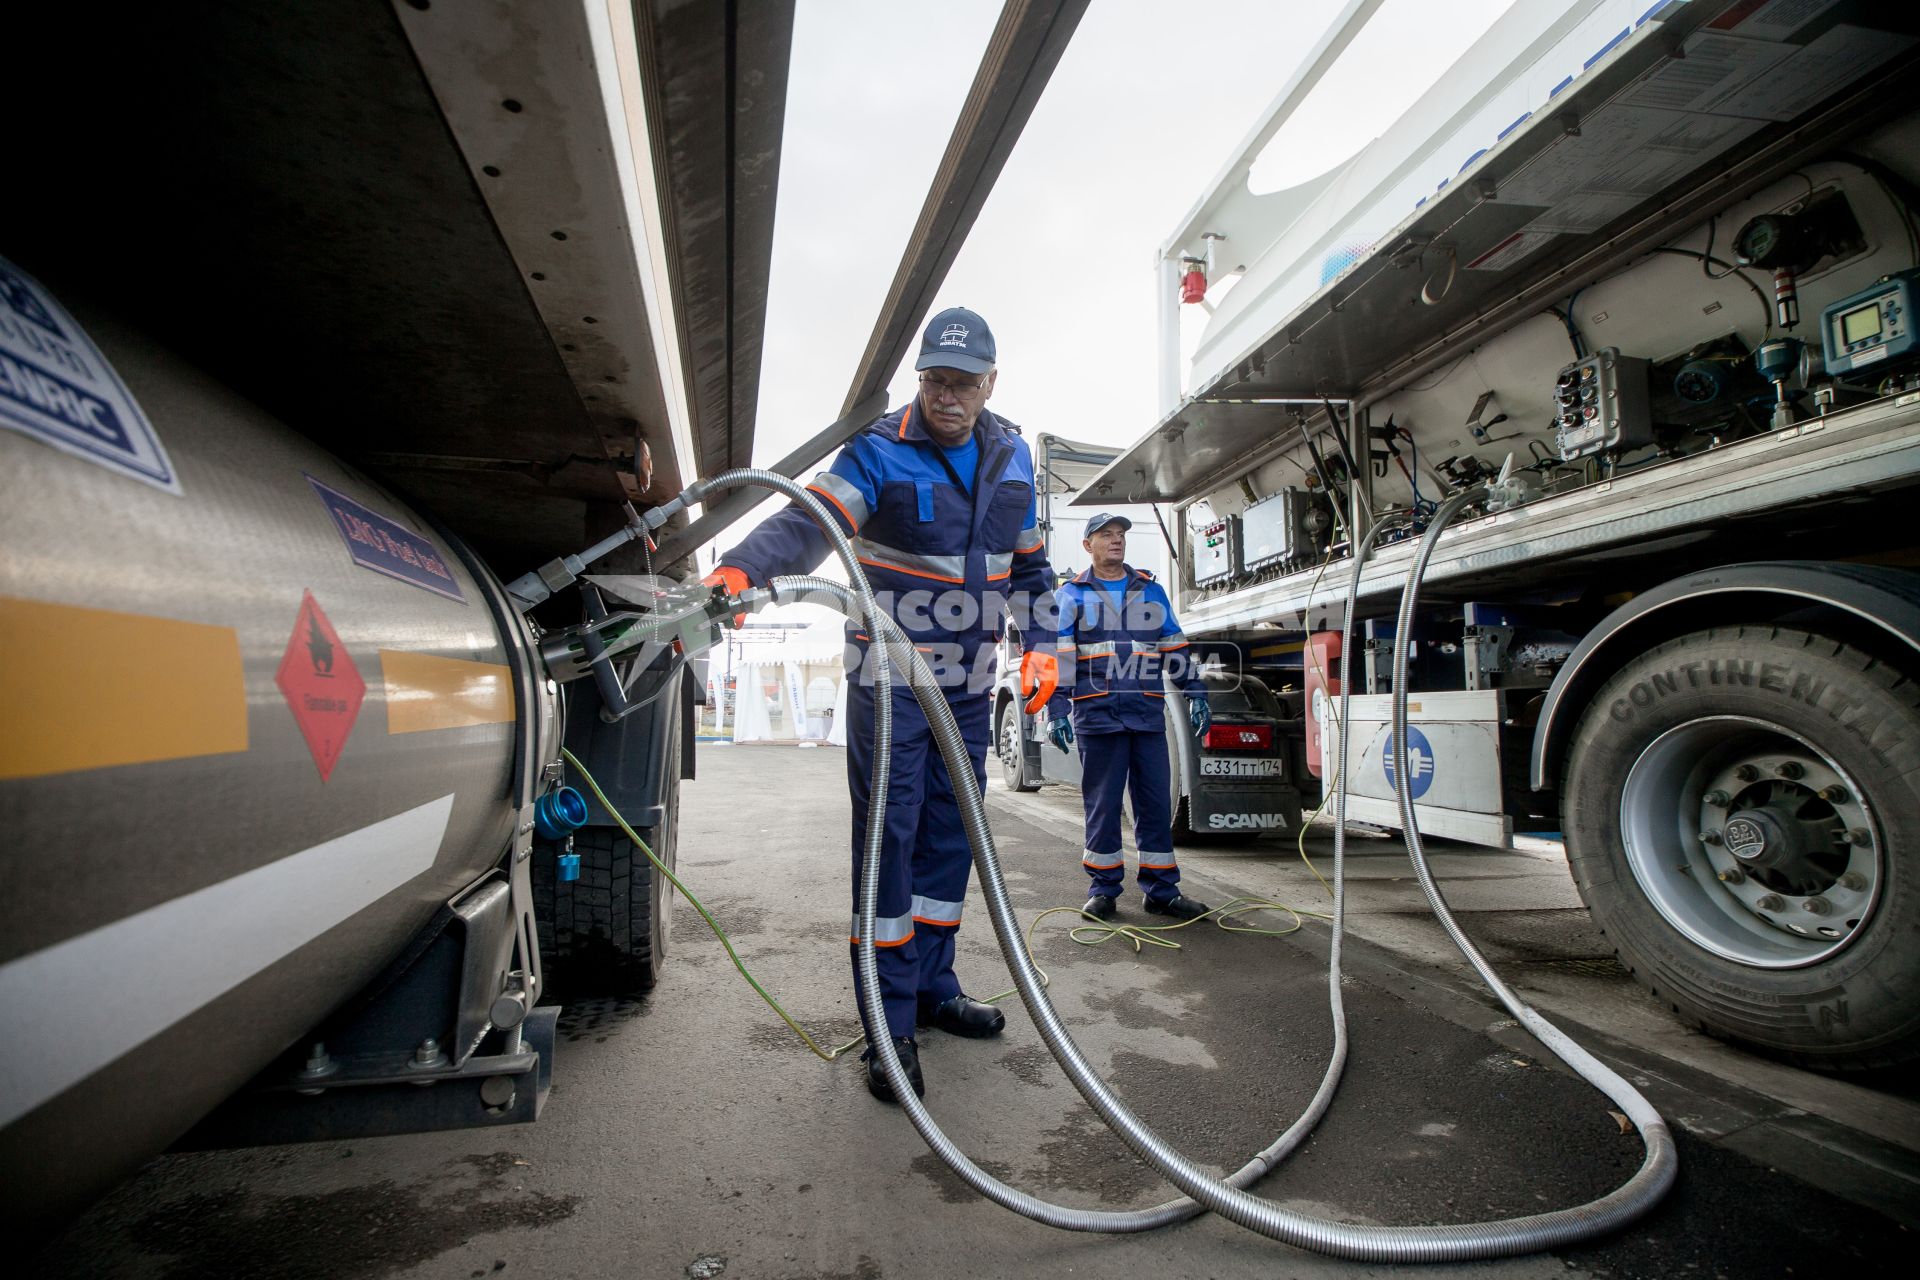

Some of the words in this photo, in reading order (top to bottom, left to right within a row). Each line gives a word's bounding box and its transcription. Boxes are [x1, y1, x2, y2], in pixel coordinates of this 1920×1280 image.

[334, 507, 386, 553] LNG
[1609, 658, 1902, 769] CONTINENTAL
[1260, 760, 1280, 772] 174
[1208, 813, 1289, 828] SCANIA
